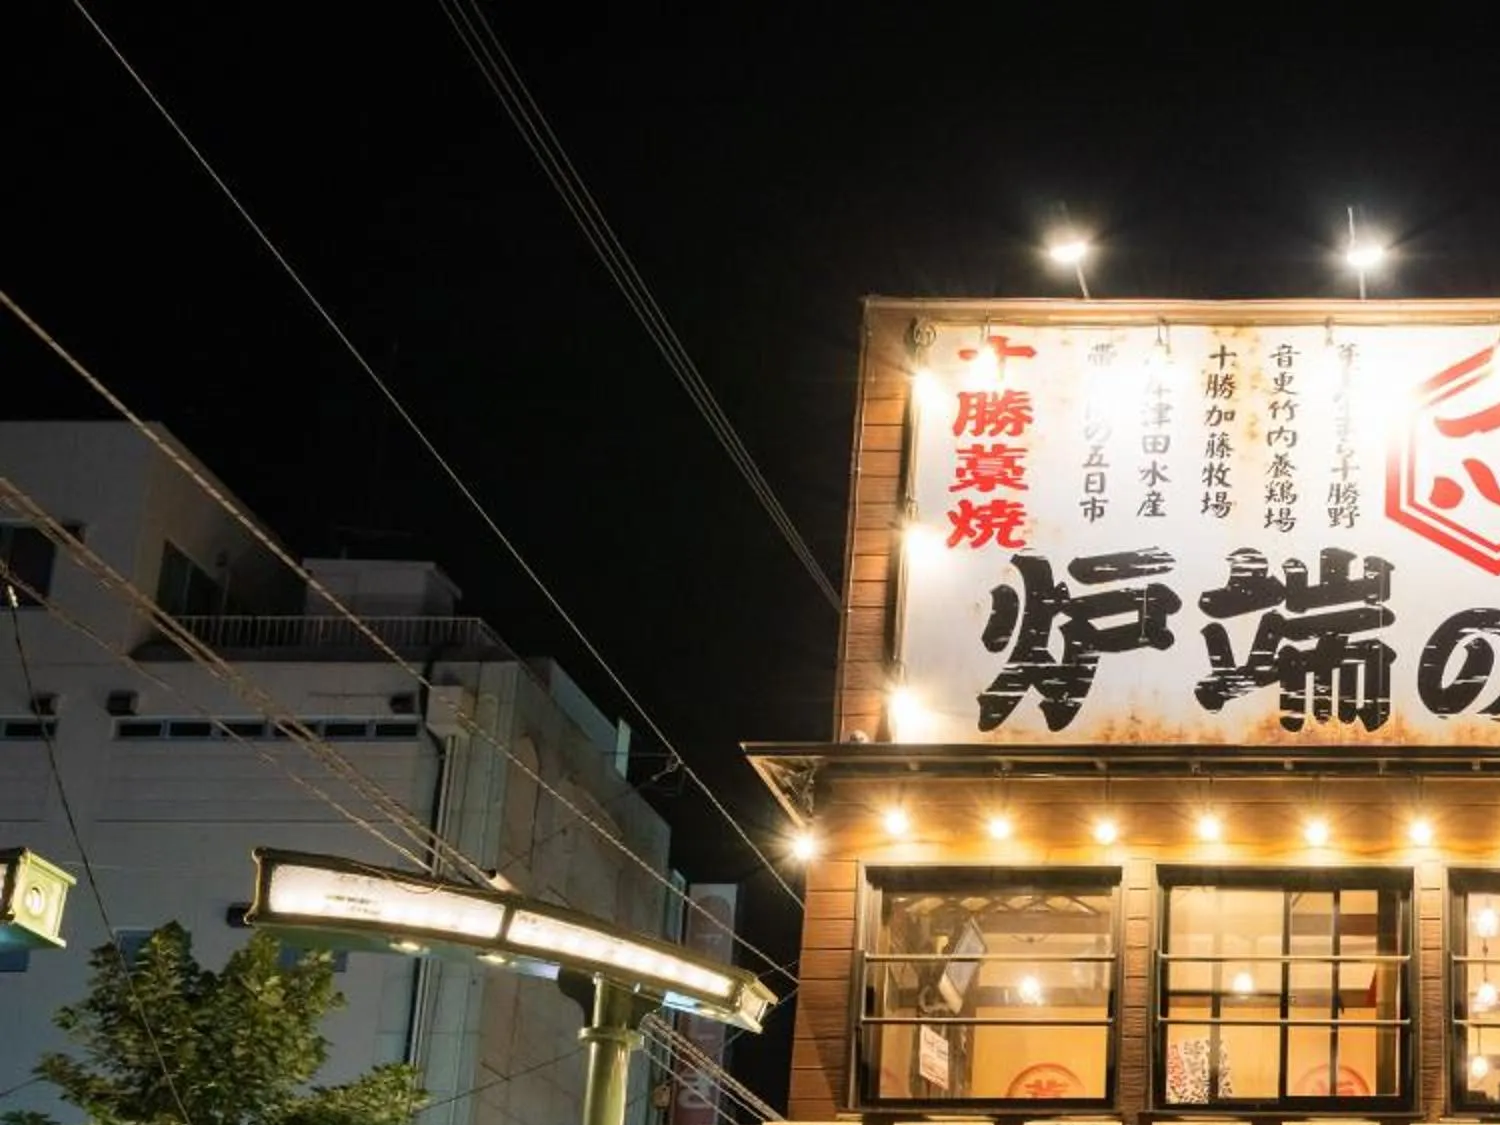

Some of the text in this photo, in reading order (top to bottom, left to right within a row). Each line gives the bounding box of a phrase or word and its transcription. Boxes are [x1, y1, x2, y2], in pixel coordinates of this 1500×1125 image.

[945, 335, 1037, 549] 十勝藁焼
[1200, 344, 1238, 518] 十勝加藤牧場
[1263, 343, 1302, 532] 音更竹内養鶏場
